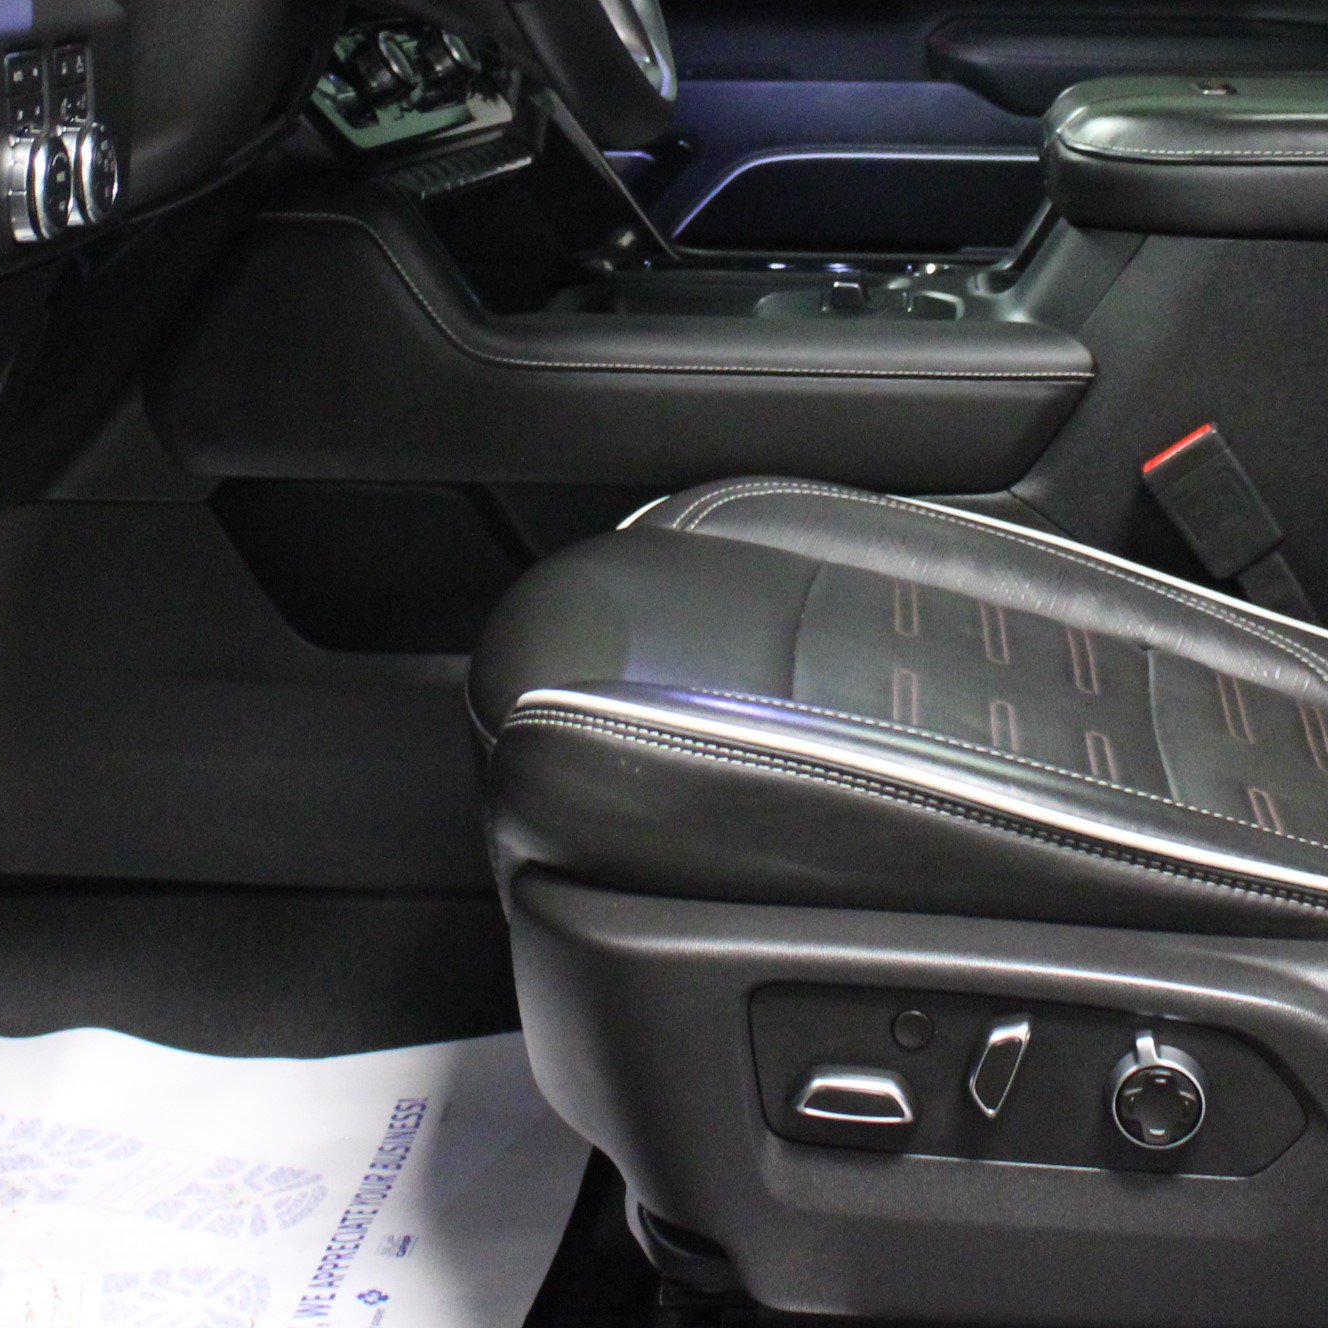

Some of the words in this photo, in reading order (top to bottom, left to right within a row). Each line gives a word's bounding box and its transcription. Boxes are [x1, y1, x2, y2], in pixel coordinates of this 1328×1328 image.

[368, 1097, 429, 1171] BUSINESS!
[348, 1173, 398, 1207] YOUR
[308, 1207, 380, 1289] APPRECIATE
[292, 1292, 337, 1319] WE
